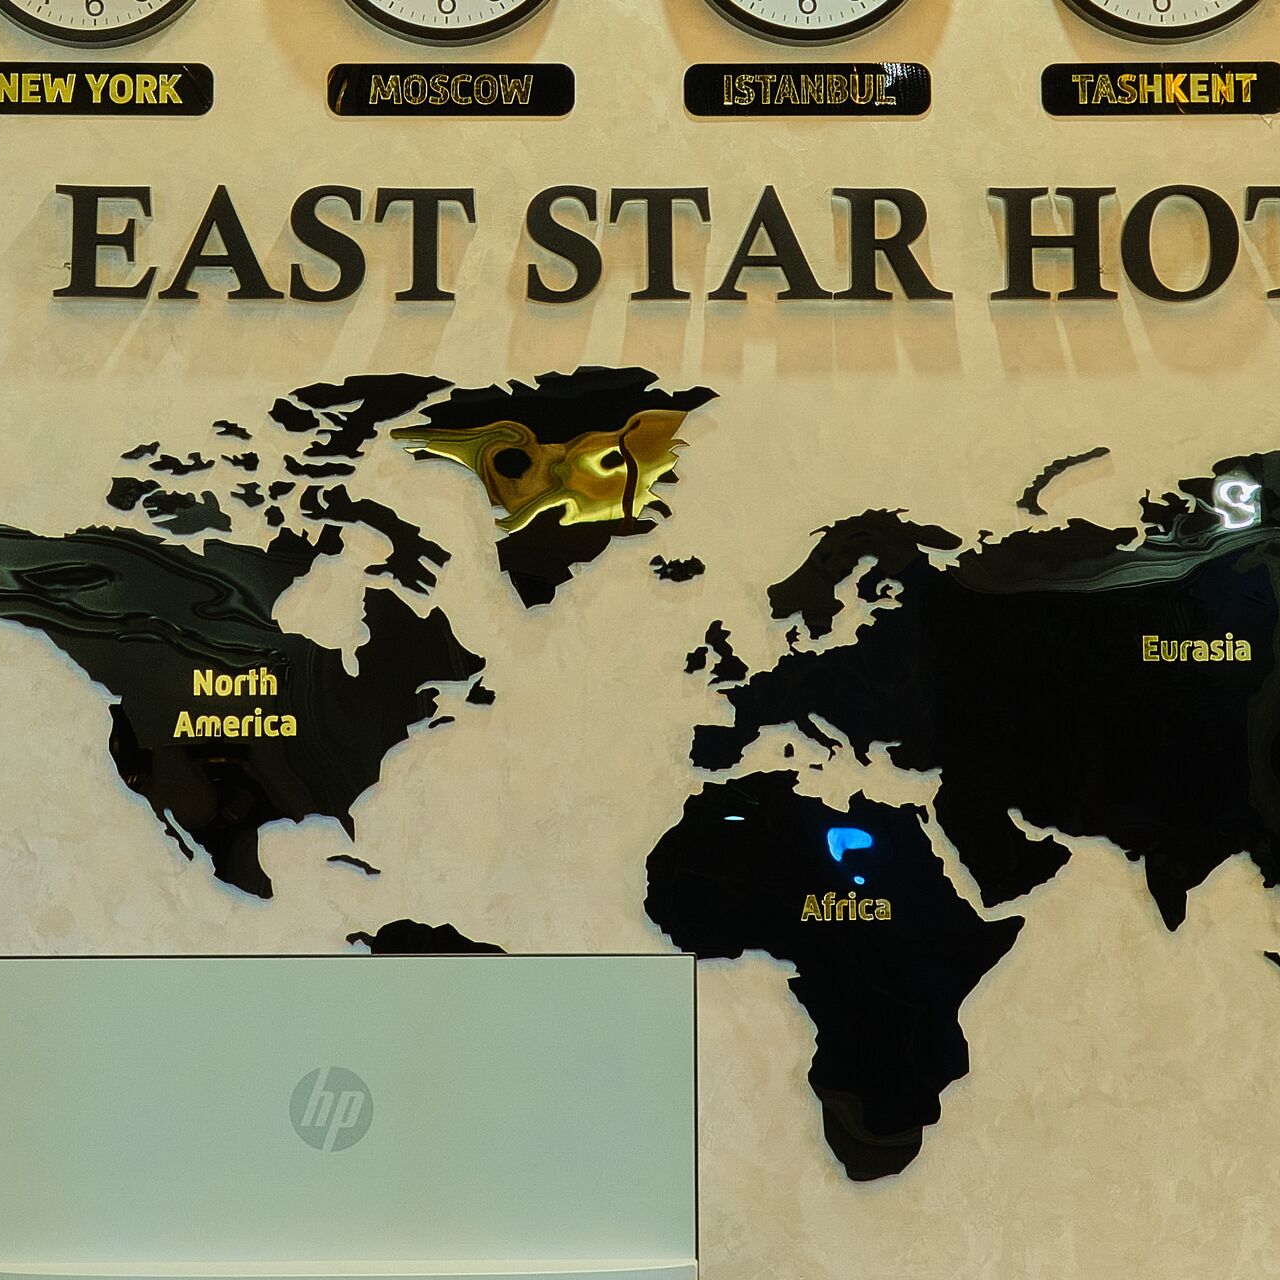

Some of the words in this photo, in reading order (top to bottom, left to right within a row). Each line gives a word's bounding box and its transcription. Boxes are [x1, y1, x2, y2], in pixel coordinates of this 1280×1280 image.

[84, 73, 183, 104] YORK
[370, 74, 534, 105] MOSCOW
[723, 74, 896, 106] ISTANBUL
[1071, 73, 1258, 104] TASHKENT
[53, 184, 476, 302] EAST
[526, 184, 952, 303] STAR
[1142, 632, 1252, 661] Eurasia
[193, 667, 278, 696] North
[173, 707, 297, 738] America
[800, 891, 892, 921] Africa
[301, 1067, 365, 1151] hp
